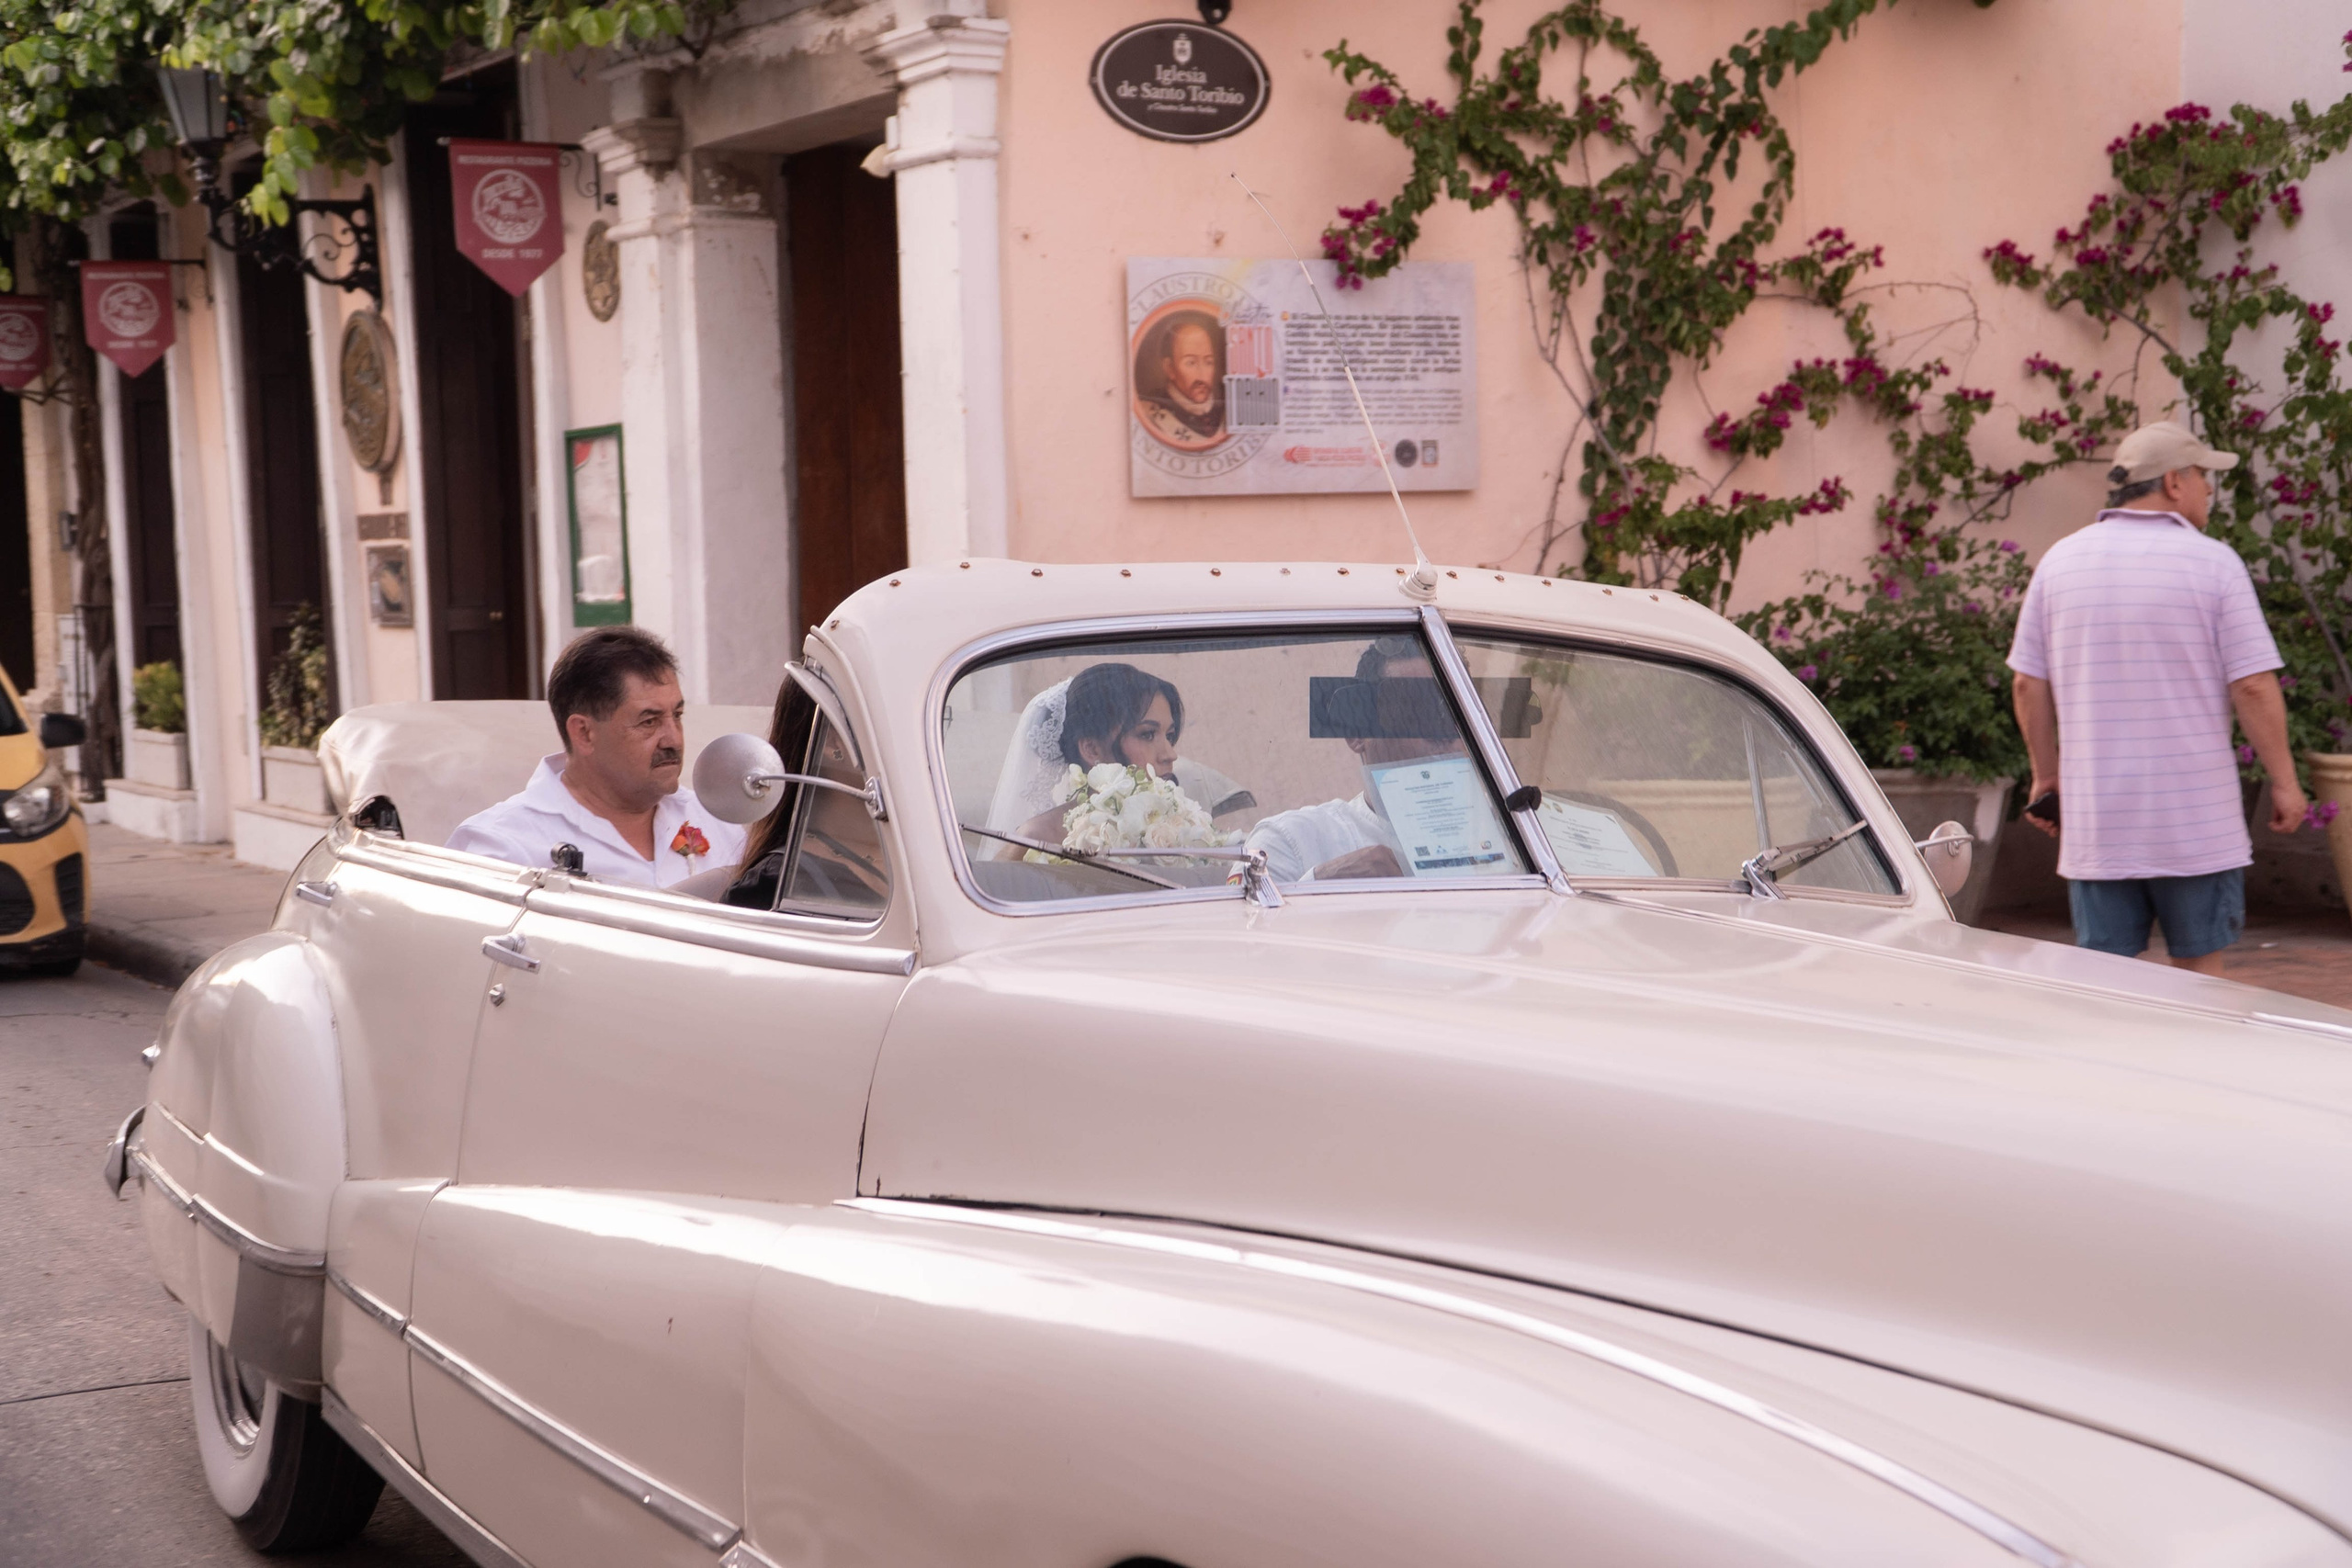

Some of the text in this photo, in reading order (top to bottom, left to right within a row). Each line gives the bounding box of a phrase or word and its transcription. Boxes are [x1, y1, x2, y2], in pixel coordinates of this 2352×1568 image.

[1155, 64, 1208, 85] Iglesia
[1115, 80, 1246, 105] de Santo Toribio
[1128, 276, 1235, 325] CLAUSTRO
[1193, 436, 1261, 474] TORIB
